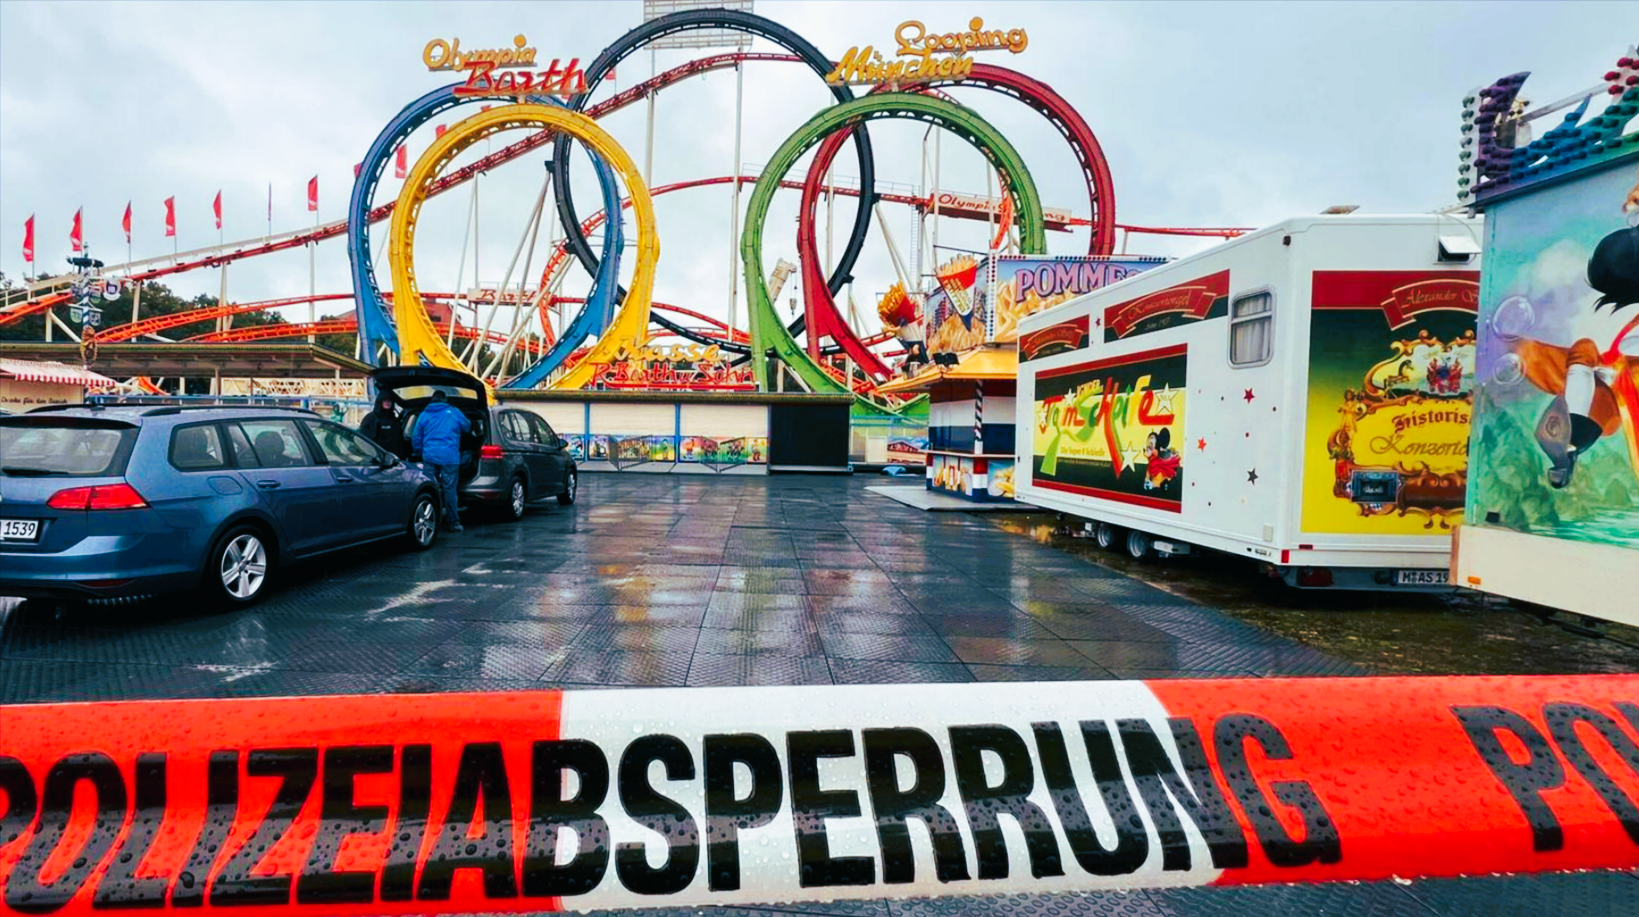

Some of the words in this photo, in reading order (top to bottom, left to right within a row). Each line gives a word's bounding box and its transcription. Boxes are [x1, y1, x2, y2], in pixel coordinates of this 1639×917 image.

[423, 34, 537, 71] Olympia
[895, 16, 1028, 56] Looping
[453, 58, 589, 96] Barth
[825, 45, 974, 84] München
[1391, 407, 1472, 434] Historis
[3, 521, 36, 536] 1539
[1450, 701, 1639, 851] PO
